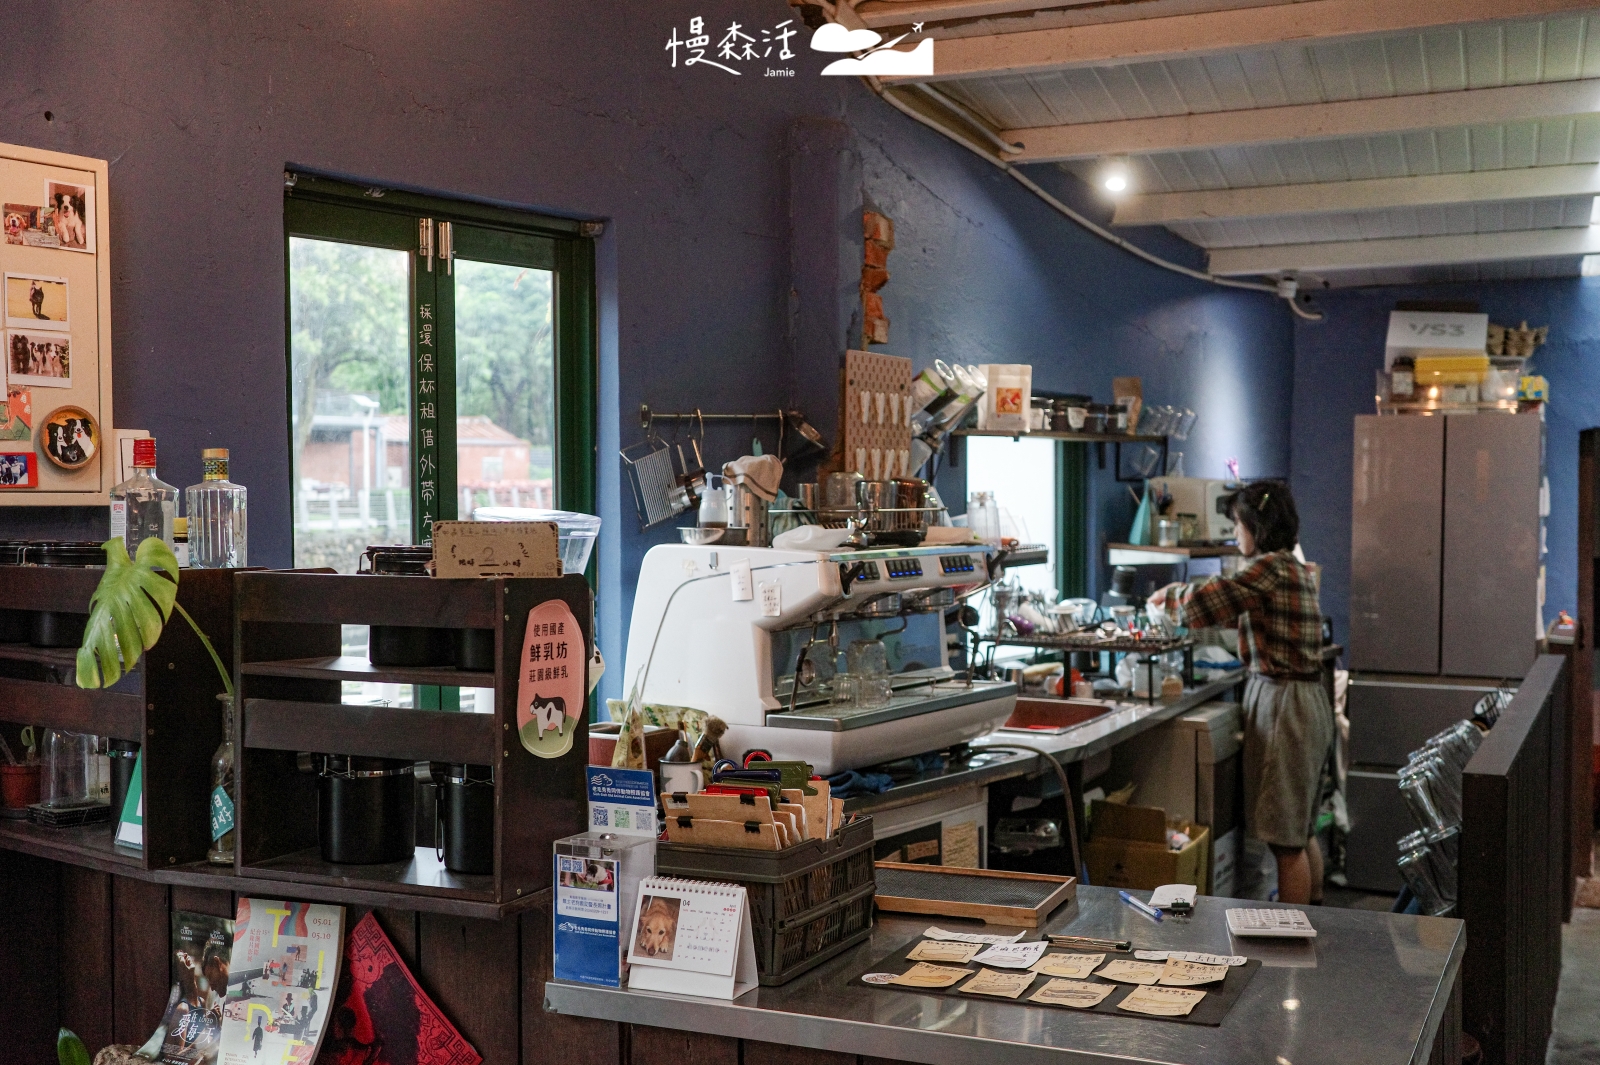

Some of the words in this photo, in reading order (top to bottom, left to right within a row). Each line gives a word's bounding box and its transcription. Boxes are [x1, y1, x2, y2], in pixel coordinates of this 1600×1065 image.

[533, 621, 565, 638] 使用國產
[529, 641, 568, 663] 鮮乳坊
[528, 664, 569, 683] 莊園級鮮乳
[312, 917, 332, 927] 05.01
[311, 931, 332, 941] 05.10
